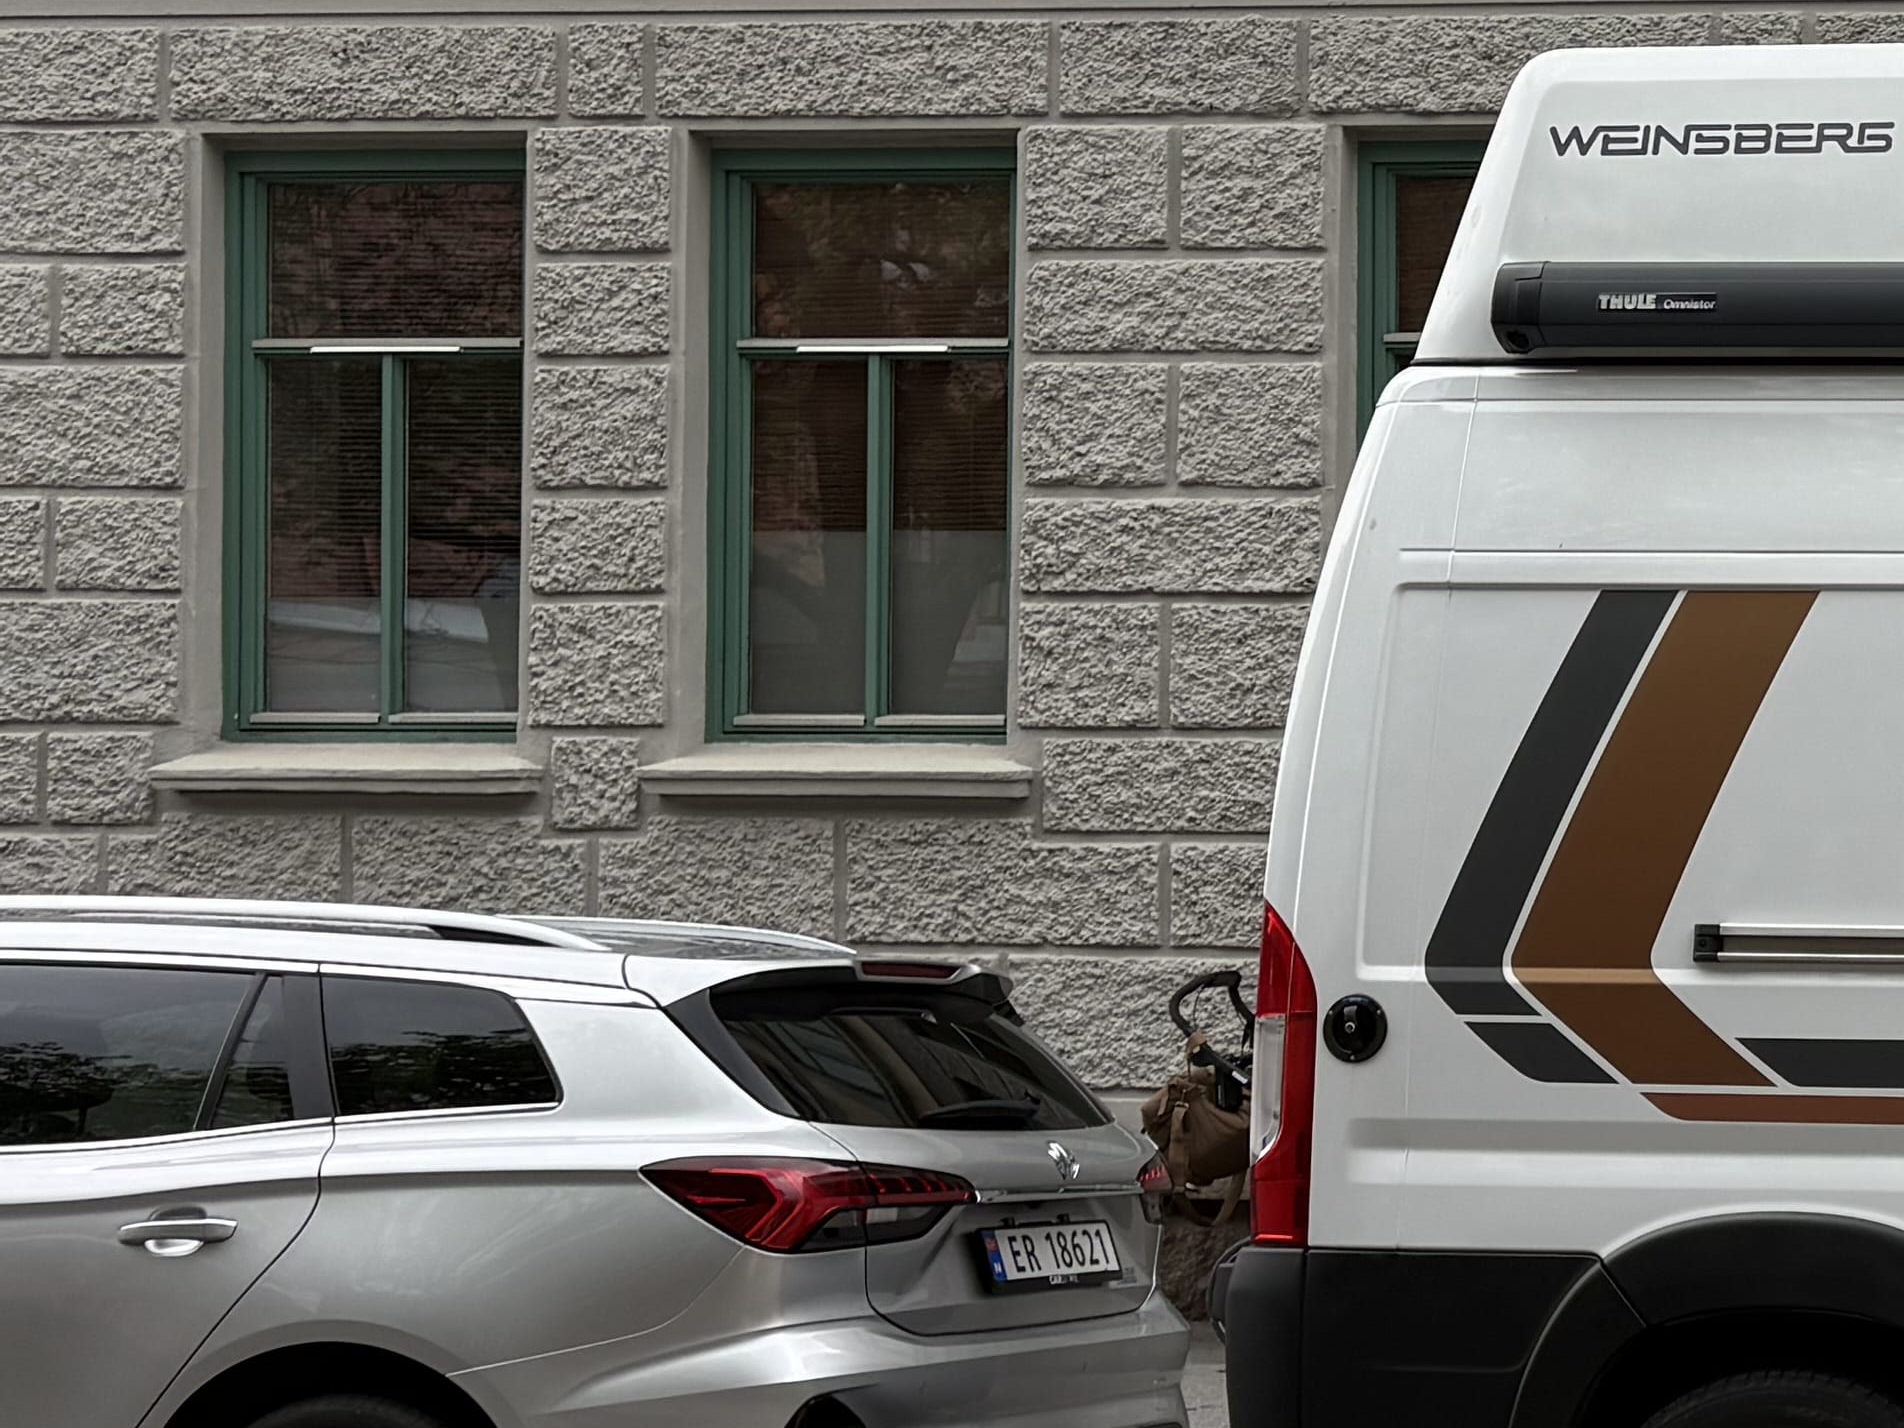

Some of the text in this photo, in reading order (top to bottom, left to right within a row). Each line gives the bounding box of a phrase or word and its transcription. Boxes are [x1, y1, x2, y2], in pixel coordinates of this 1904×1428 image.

[1549, 122, 1895, 156] WEINSBERG
[1598, 293, 1717, 310] THULE Omnistor
[1007, 1234, 1042, 1273] ER
[1044, 1228, 1110, 1270] 18621
